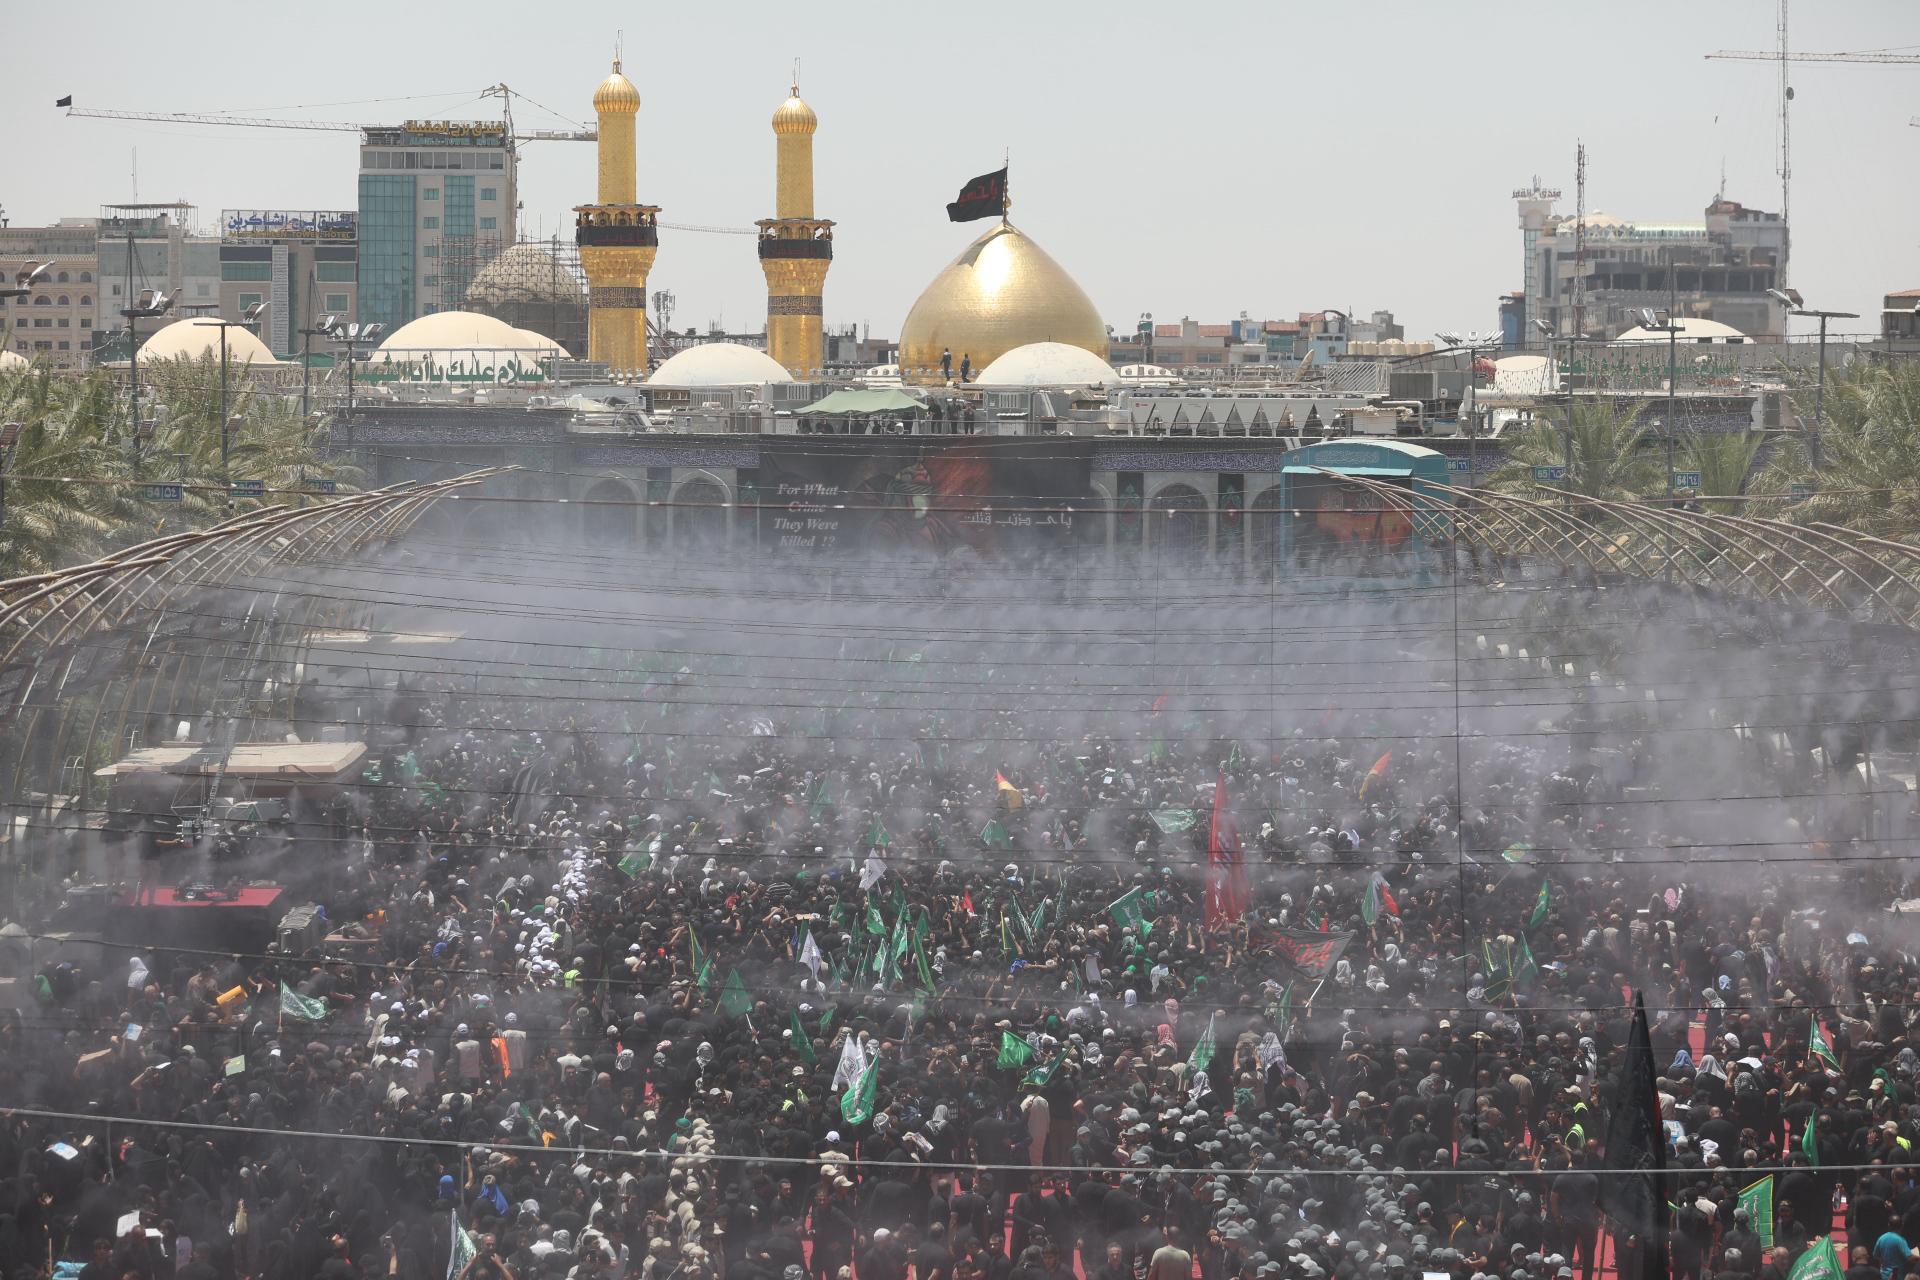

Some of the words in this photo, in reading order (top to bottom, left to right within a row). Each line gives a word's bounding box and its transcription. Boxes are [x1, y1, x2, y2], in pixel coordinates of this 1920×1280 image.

[451, 122, 470, 137] برج
[472, 121, 504, 136] فندق
[1676, 475, 1687, 485] 64
[777, 483, 800, 495] For
[804, 483, 839, 496] What
[788, 500, 827, 512] Crime
[774, 518, 804, 532] They
[807, 518, 839, 530] Were
[779, 535, 816, 547] Killed
